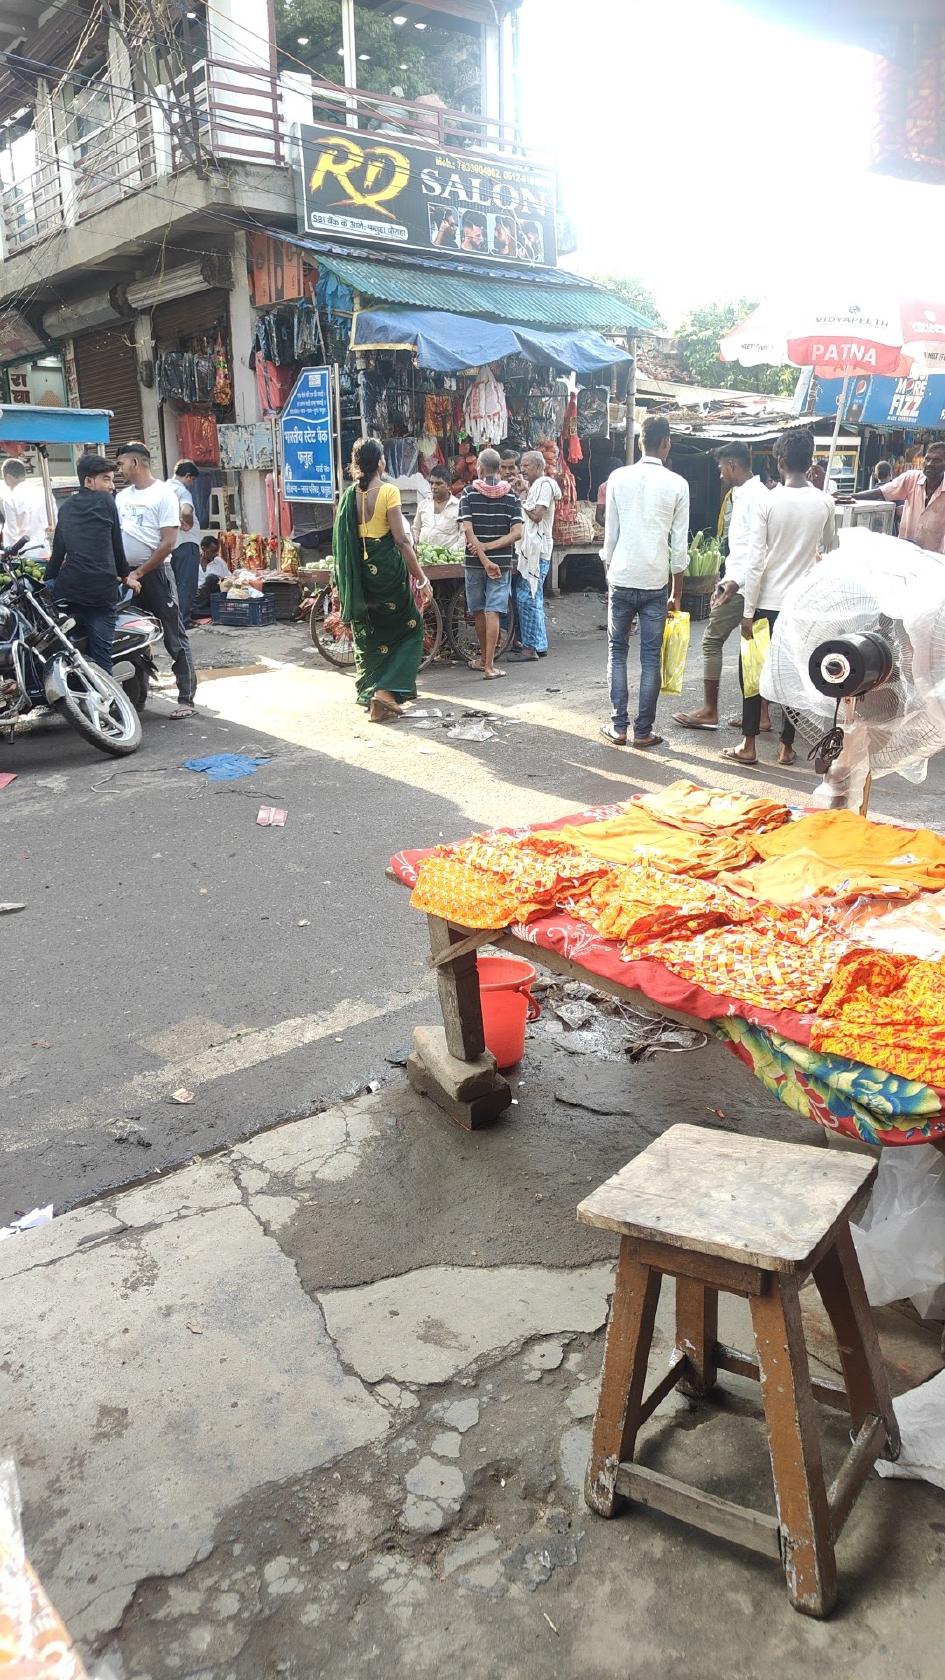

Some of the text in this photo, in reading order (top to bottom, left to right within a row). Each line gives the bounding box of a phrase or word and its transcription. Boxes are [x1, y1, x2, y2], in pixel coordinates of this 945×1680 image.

[420, 167, 548, 217] SALON
[815, 315, 889, 328] VIDYAPEETH
[811, 343, 878, 366] PATNA
[888, 394, 922, 418] FIZZ
